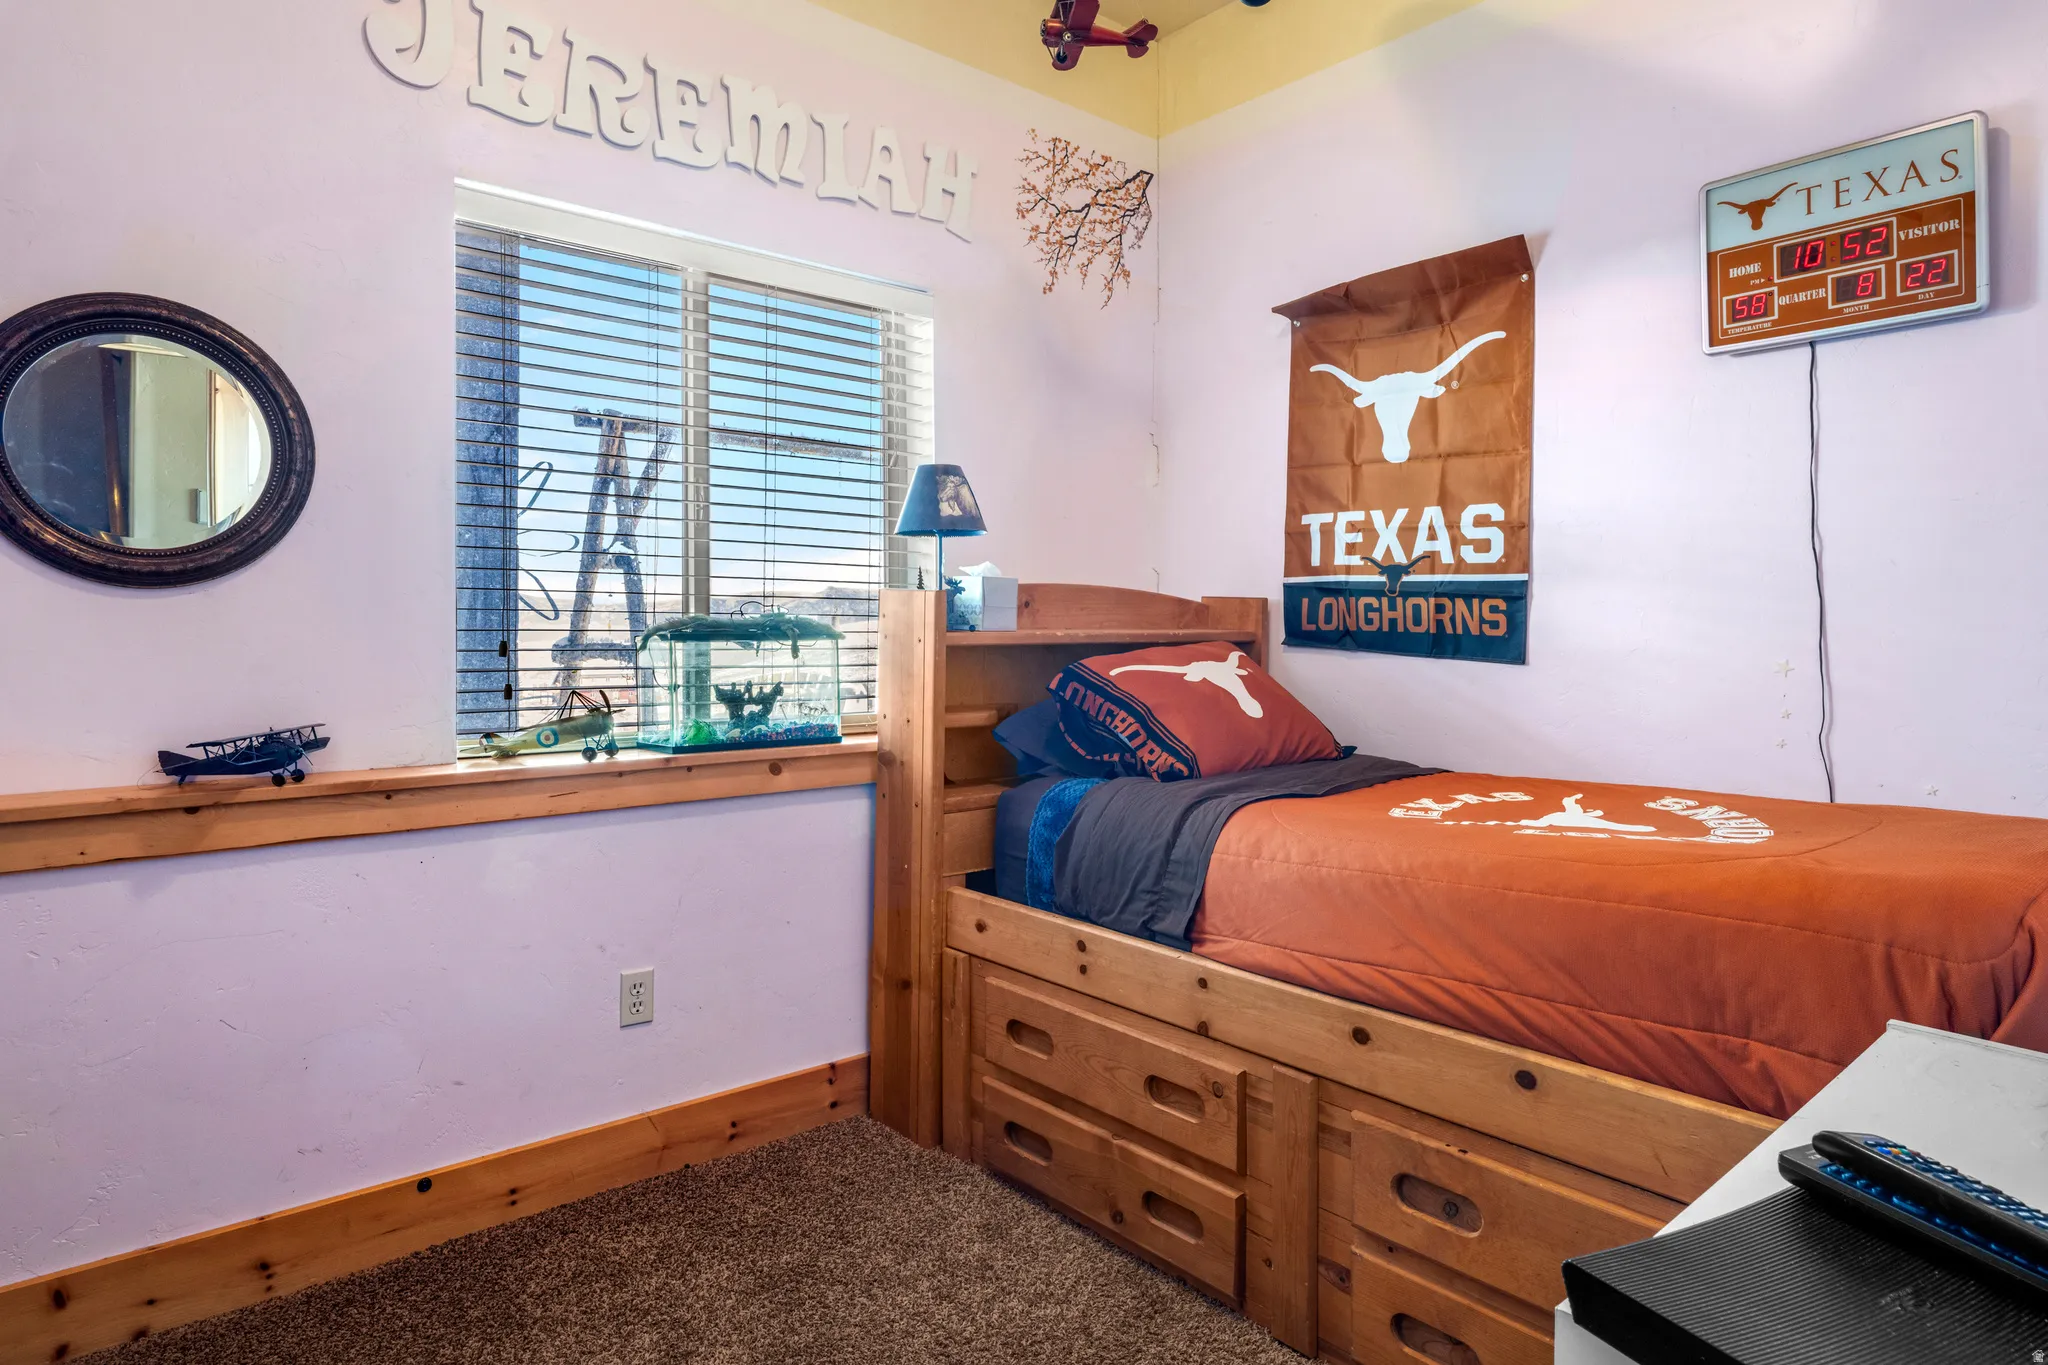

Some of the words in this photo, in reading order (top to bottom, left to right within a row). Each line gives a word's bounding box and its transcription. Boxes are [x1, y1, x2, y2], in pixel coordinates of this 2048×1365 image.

[1795, 149, 1960, 215] TEXAS
[1898, 218, 1960, 241] VISITOR
[1793, 226, 1888, 270] 10:52
[1729, 262, 1762, 278] HOME
[1906, 258, 1947, 288] 22
[1778, 287, 1827, 306] QUARTER
[1856, 272, 1875, 297] 8
[1918, 292, 1935, 300] DAY
[1735, 293, 1767, 319] 58
[1842, 304, 1870, 314] MONTH
[1727, 322, 1773, 335] TEMPERATURE
[1301, 503, 1506, 567] TEXAS
[1302, 596, 1508, 636] LONGHORNS
